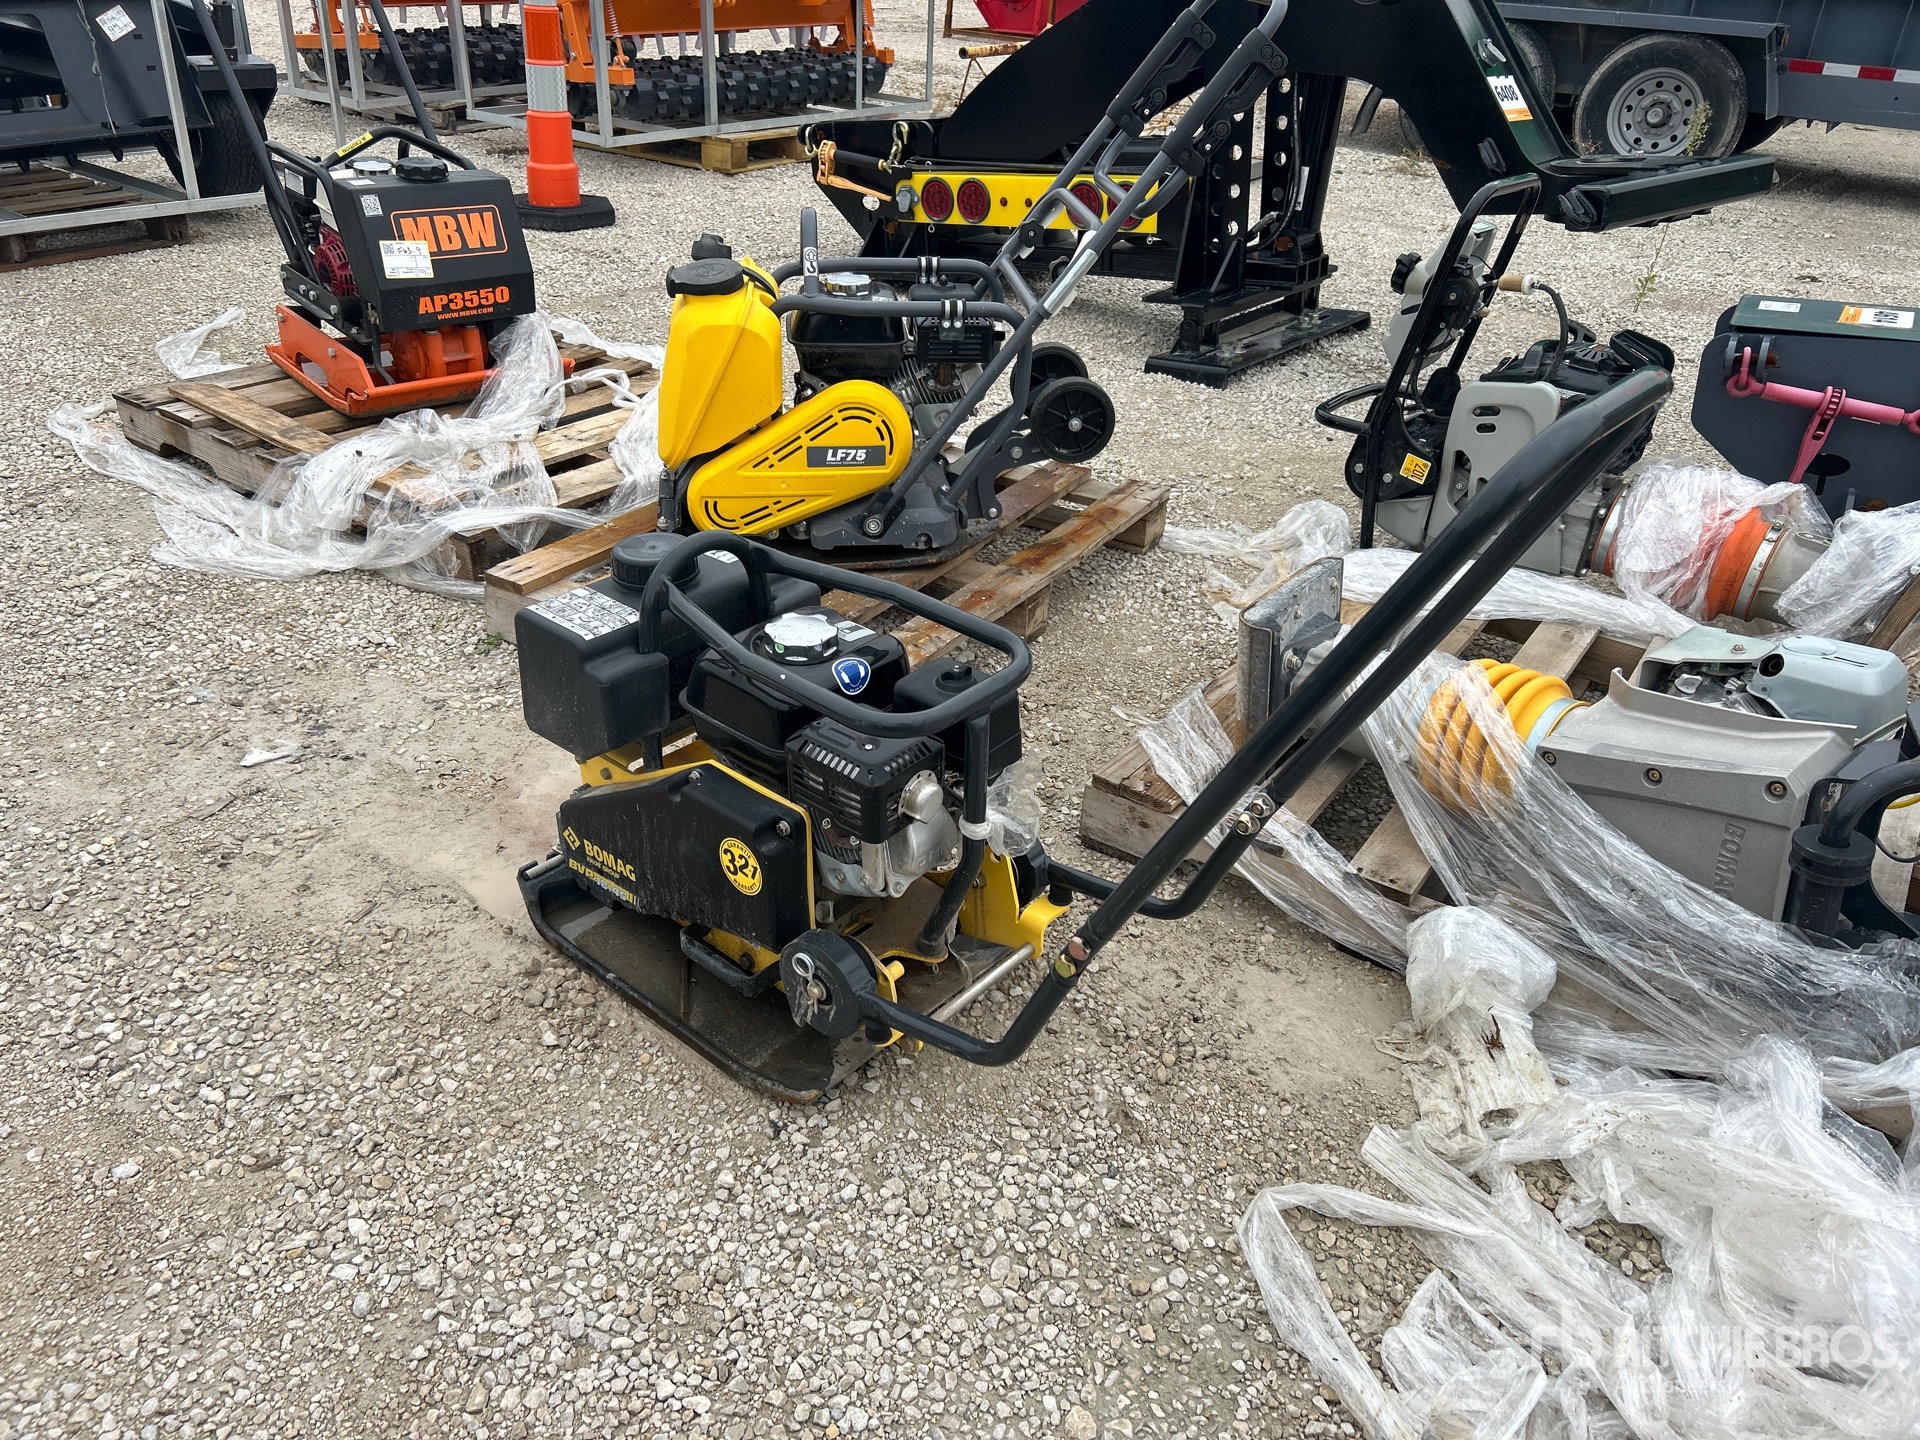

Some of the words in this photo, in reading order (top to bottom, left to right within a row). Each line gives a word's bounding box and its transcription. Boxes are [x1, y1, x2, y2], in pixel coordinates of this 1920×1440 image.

[1494, 85, 1519, 102] 6408
[400, 211, 497, 253] MBW
[419, 286, 510, 315] AP3550
[437, 307, 494, 320] WWW.MBW.COM
[826, 449, 867, 462] LF75
[1411, 463, 1426, 481] 107
[583, 839, 637, 882] BOMAG
